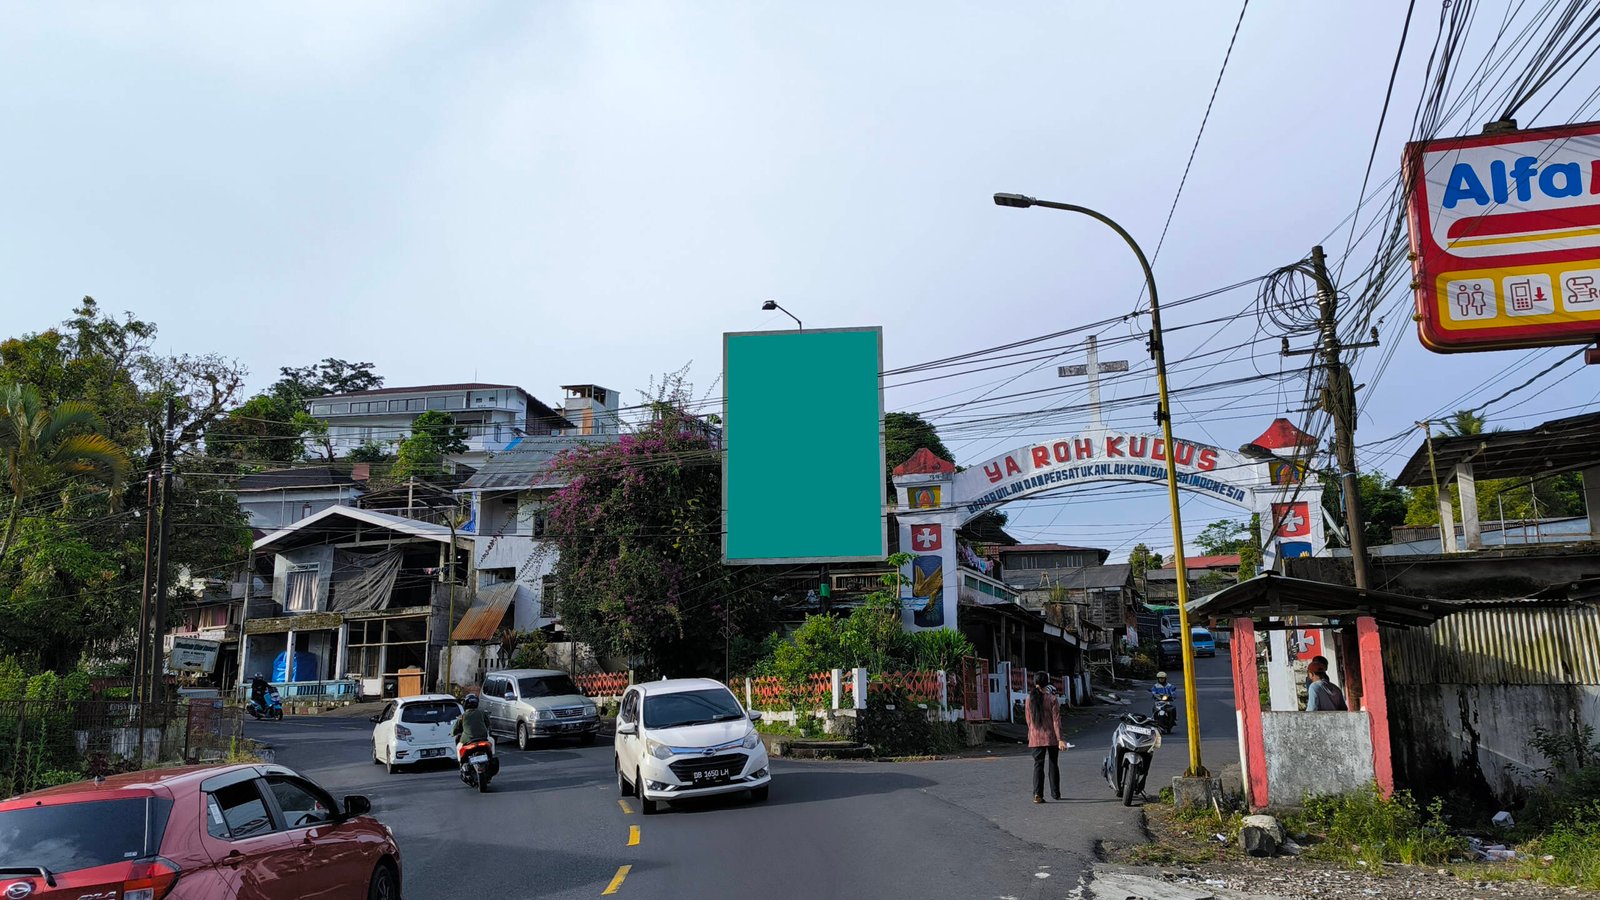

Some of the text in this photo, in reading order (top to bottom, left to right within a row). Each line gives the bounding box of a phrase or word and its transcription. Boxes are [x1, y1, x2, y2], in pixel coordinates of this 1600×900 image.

[1442, 156, 1600, 209] Alfa
[984, 436, 1218, 484] YA ROH KUDUS
[1150, 465, 1188, 485] BANSA
[1187, 475, 1246, 503] INDONESIA
[693, 771, 703, 779] DB
[704, 769, 719, 778] 1650
